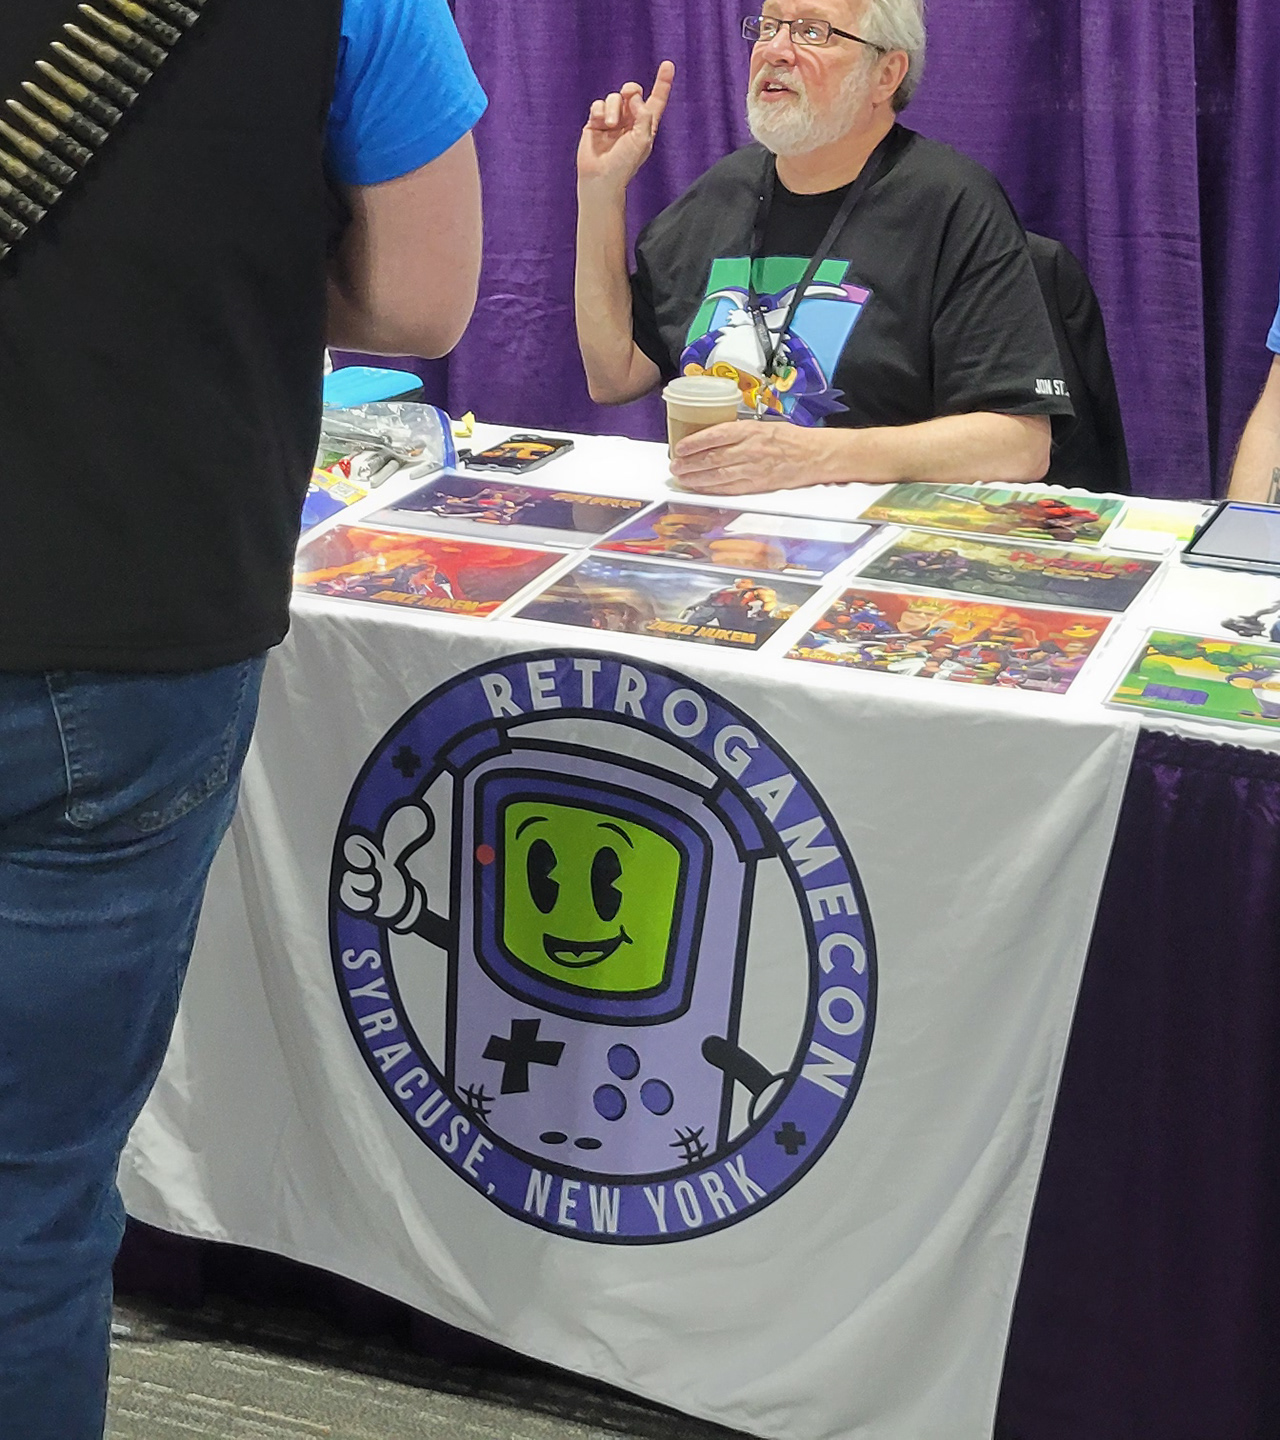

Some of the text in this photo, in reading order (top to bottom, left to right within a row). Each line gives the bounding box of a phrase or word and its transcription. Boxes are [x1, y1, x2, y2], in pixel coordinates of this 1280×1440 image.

[1035, 378, 1053, 395] JON
[479, 658, 869, 1100] RETROGAMECON
[341, 948, 767, 1235] SYRACUSE, NEW YORK
